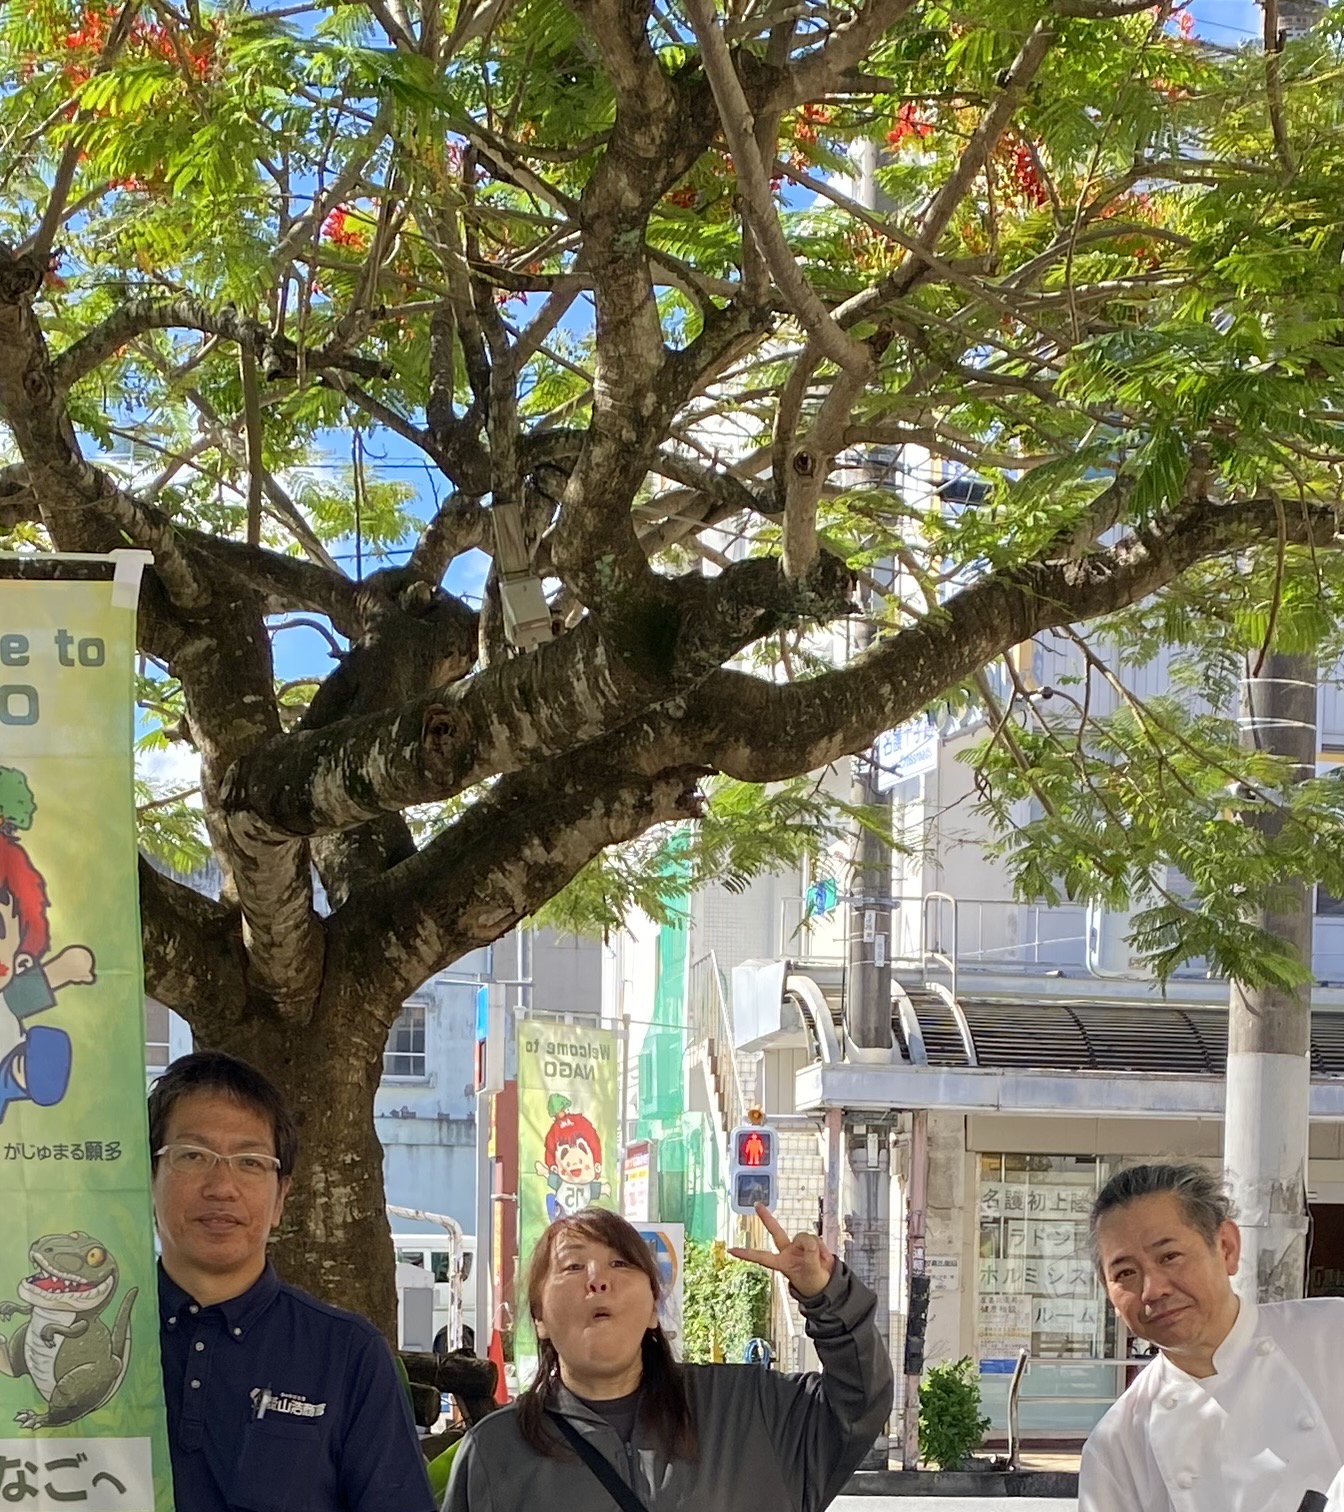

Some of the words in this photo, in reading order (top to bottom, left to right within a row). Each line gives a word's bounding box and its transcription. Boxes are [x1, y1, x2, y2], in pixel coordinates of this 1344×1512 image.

[54, 628, 105, 668] to
[3, 1141, 122, 1162] がじゅまる願多
[982, 1187, 1090, 1214] 名護初上陸
[1010, 1228, 1071, 1248] ラドン
[980, 1266, 1087, 1285] ホルミシス
[1035, 1307, 1096, 1325] ルーム
